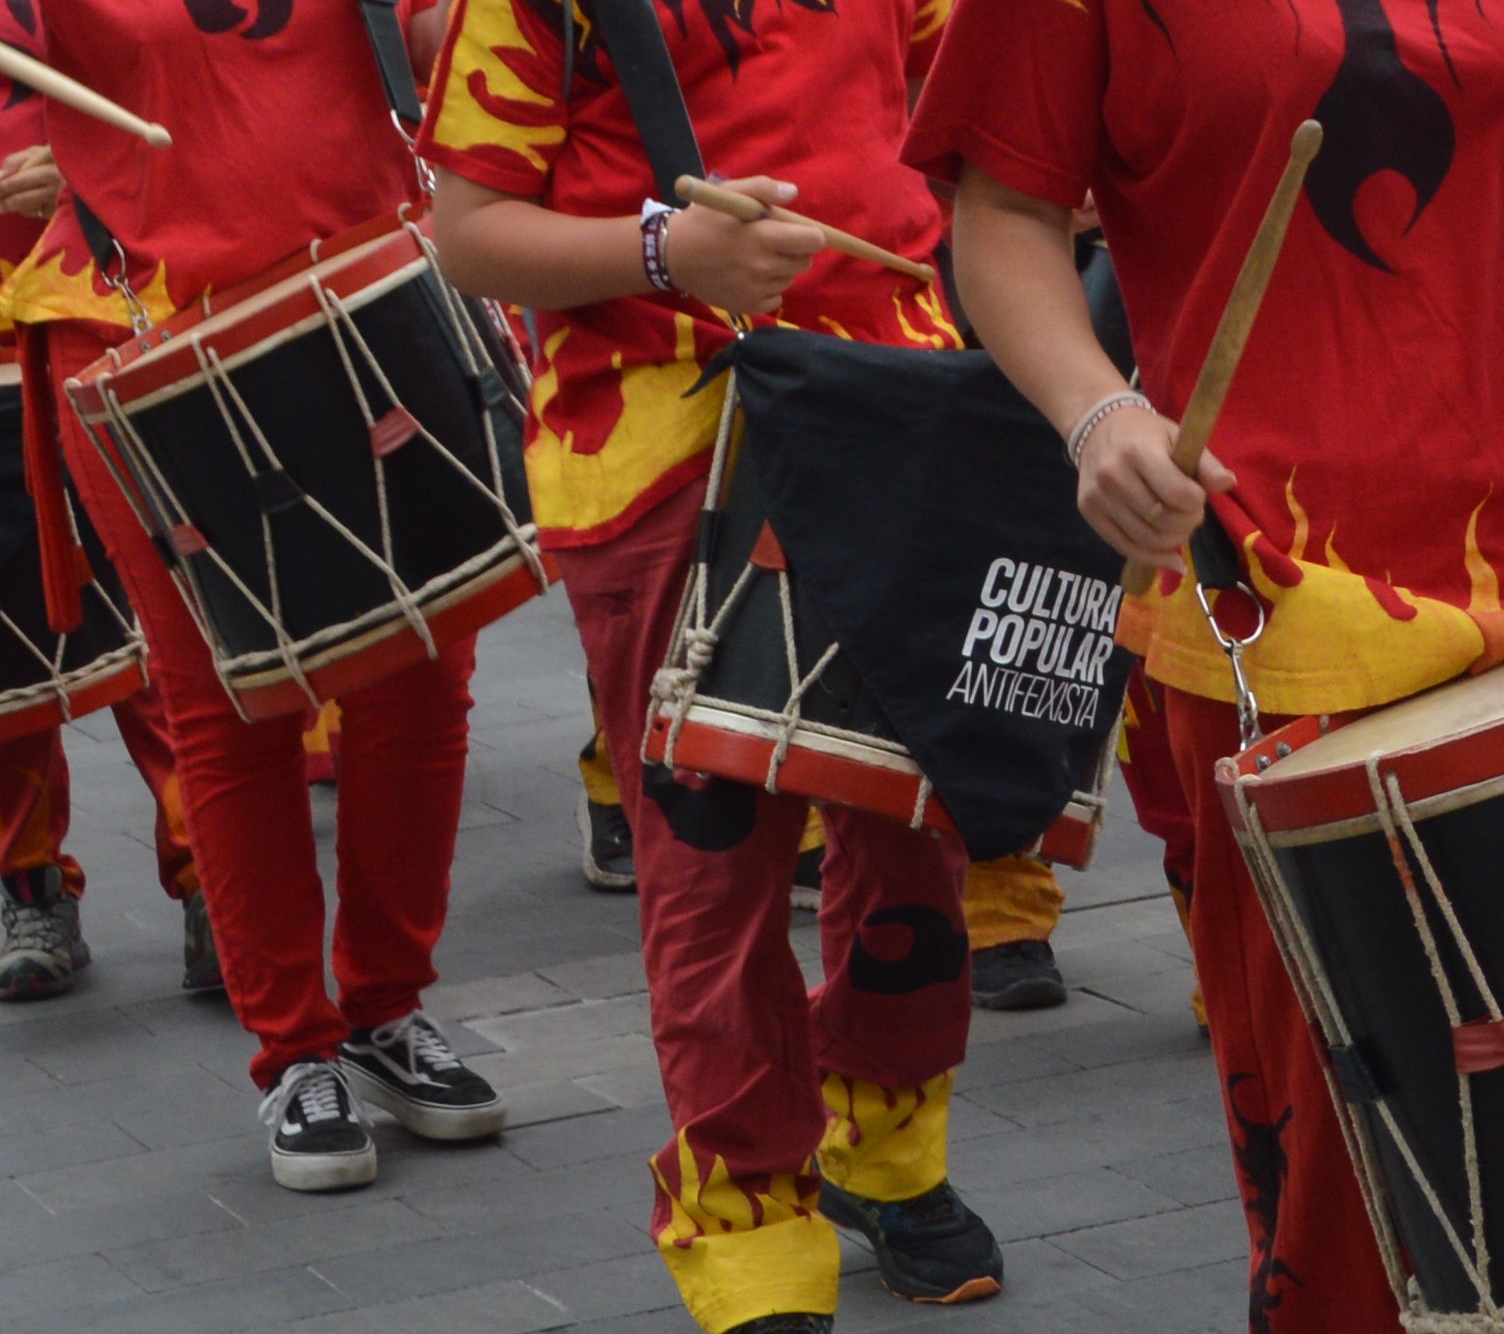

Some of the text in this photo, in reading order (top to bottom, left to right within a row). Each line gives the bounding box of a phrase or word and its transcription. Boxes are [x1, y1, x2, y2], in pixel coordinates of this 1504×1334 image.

[980, 557, 1123, 634] CULTURA
[961, 608, 1114, 686] POPULAR
[945, 660, 1100, 729] ANTIFEIXISTA
